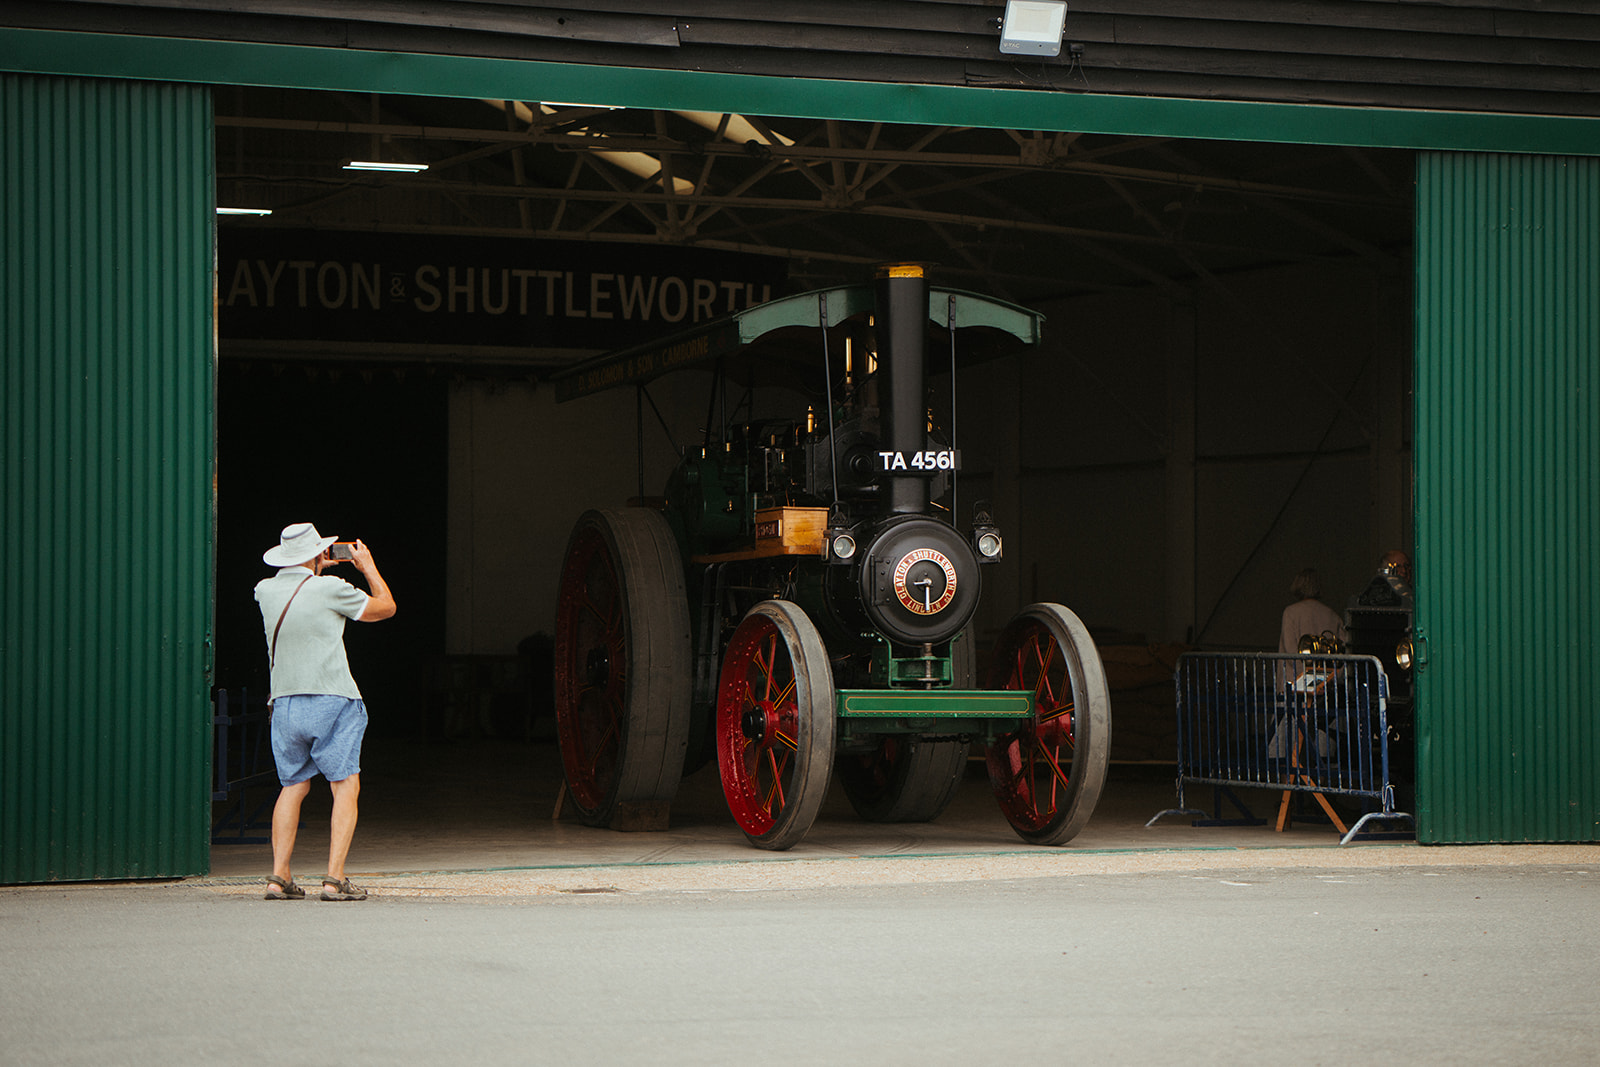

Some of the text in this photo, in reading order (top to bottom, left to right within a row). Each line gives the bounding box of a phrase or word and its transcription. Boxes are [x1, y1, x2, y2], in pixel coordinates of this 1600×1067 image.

[218, 260, 772, 323] AYTON & SHUTTLEWORTH
[637, 354, 653, 376] SON
[662, 335, 709, 367] CAMBORNE
[878, 450, 955, 471] TA 4561
[895, 560, 908, 600] CLAYTON
[912, 550, 956, 592] SHUTTLEWORTH
